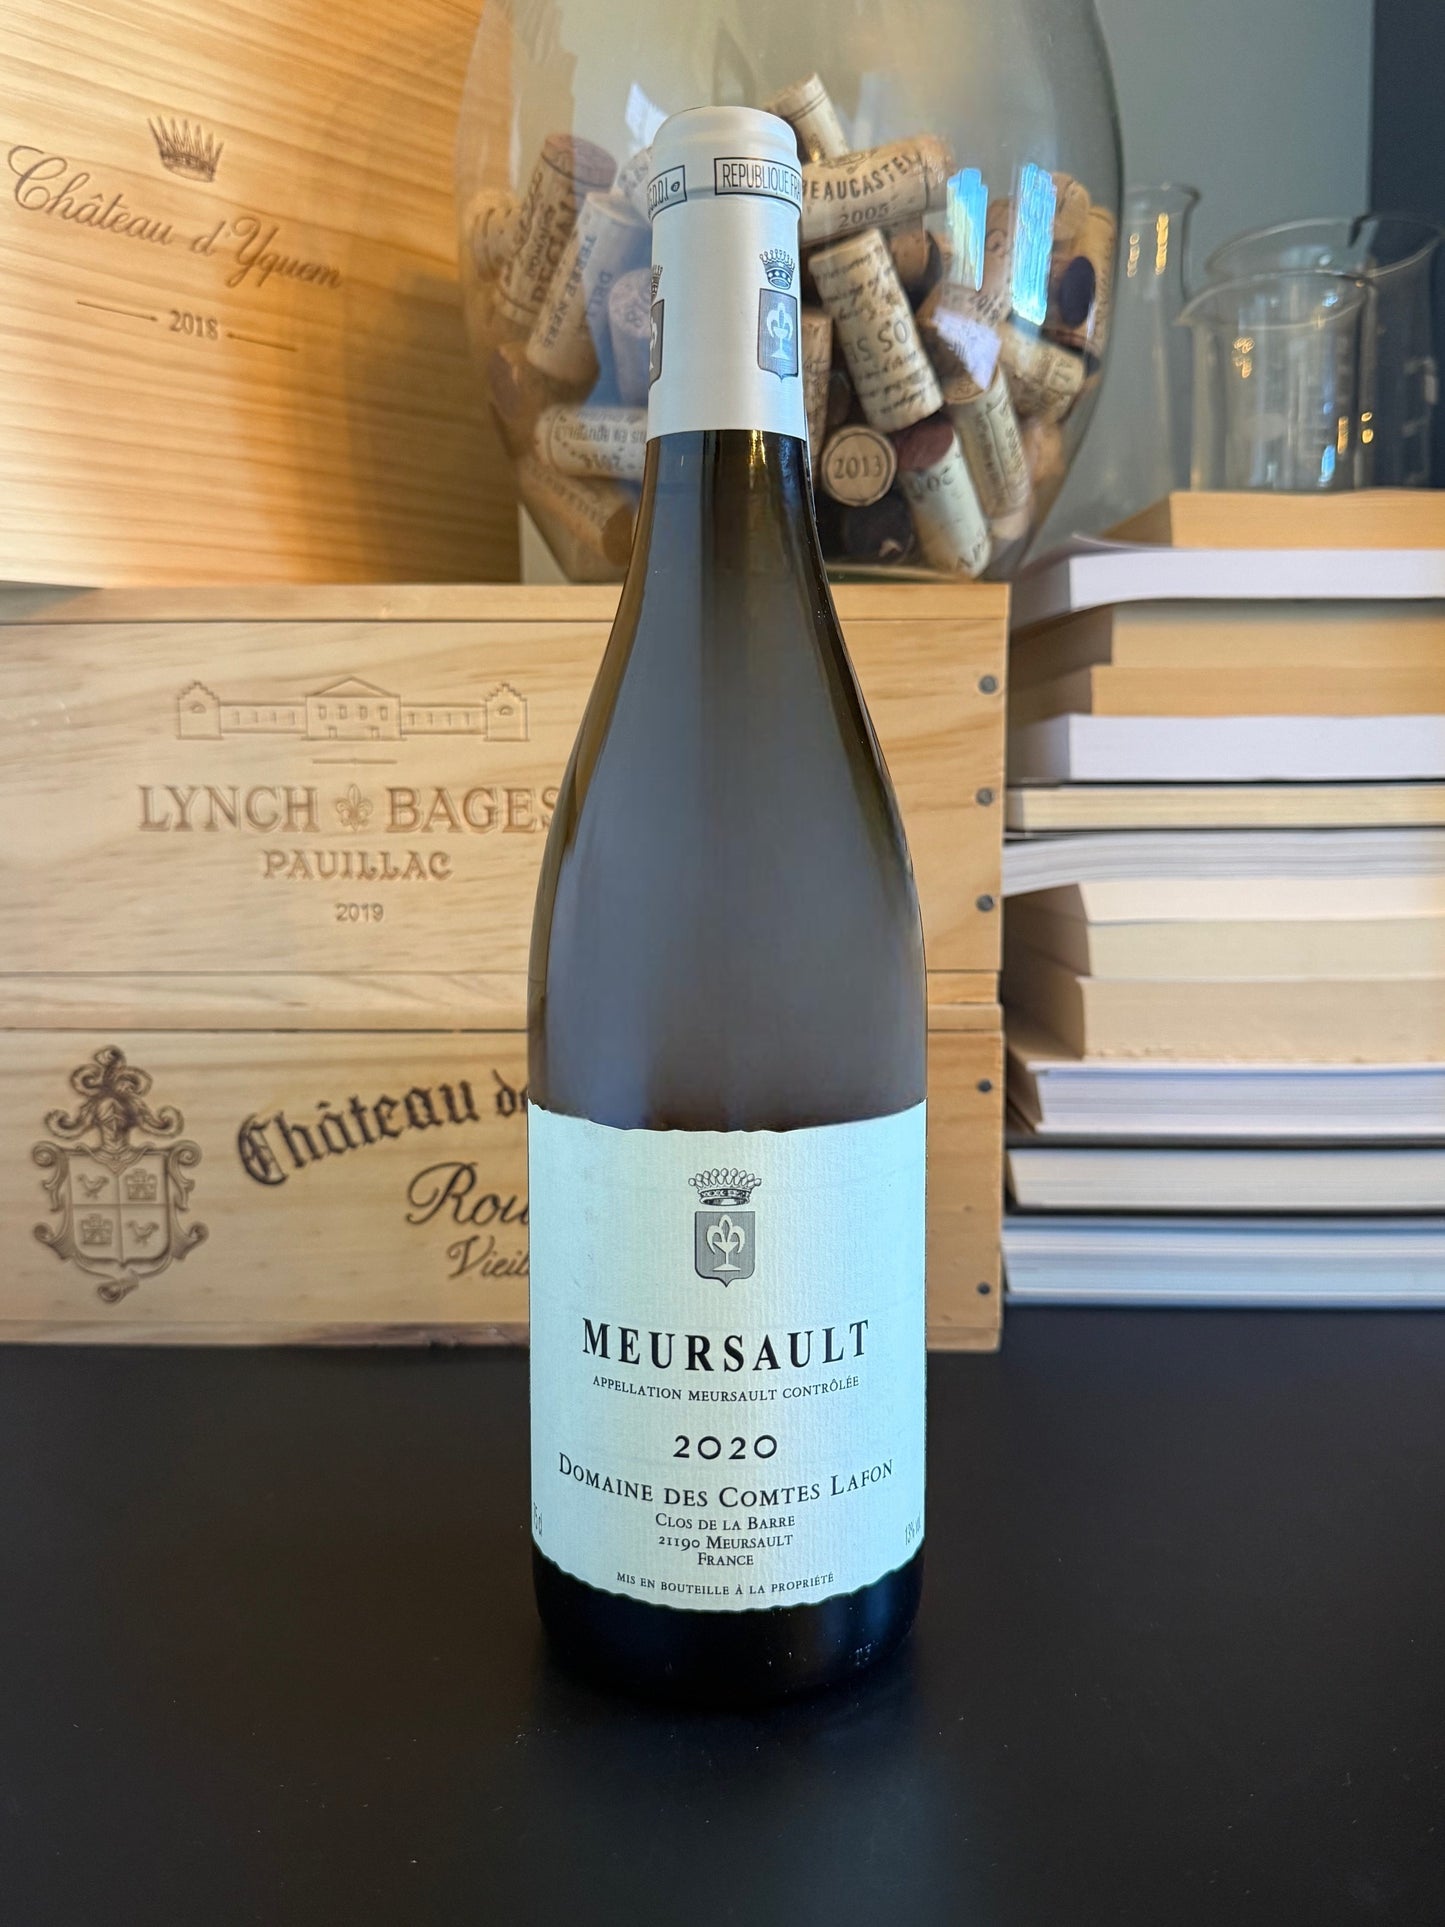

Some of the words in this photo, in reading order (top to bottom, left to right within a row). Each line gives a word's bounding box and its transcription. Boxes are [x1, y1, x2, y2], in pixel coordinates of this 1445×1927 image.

[722, 163, 789, 195] REPUBLIQUE
[7, 145, 173, 246] Château
[190, 216, 342, 288] d'Yquem
[839, 202, 889, 228] 2005
[169, 310, 219, 341] 2018
[834, 455, 882, 480] 2013
[137, 784, 320, 833] LYNCH
[385, 785, 560, 834] BAGES
[263, 849, 454, 880] PAUILLAC
[335, 902, 384, 922] 2019
[237, 1079, 481, 1186] Château
[582, 1317, 869, 1372] MEURSAULT
[593, 1375, 682, 1400] APPELLATION
[688, 1388, 778, 1402] MEURSAULT
[782, 1374, 860, 1399] CONTRÔLÉE
[673, 1434, 778, 1460] 2020
[559, 1452, 653, 1502] DOMAINE
[664, 1487, 708, 1507] DES
[719, 1482, 820, 1508] COMTES
[830, 1459, 894, 1497] LAFON
[698, 1518, 717, 1531] DE
[723, 1518, 742, 1531] LA
[658, 1535, 700, 1552] 21190
[706, 1534, 793, 1550] MEURSAULT
[697, 1551, 754, 1567] FRANCE
[616, 1571, 636, 1586] MIS
[640, 1577, 656, 1589] EN
[661, 1581, 730, 1595] BOUTEILLE
[735, 1580, 743, 1595] À
[749, 1584, 765, 1595] LA
[771, 1571, 834, 1593] PROPRIÉTÉ
